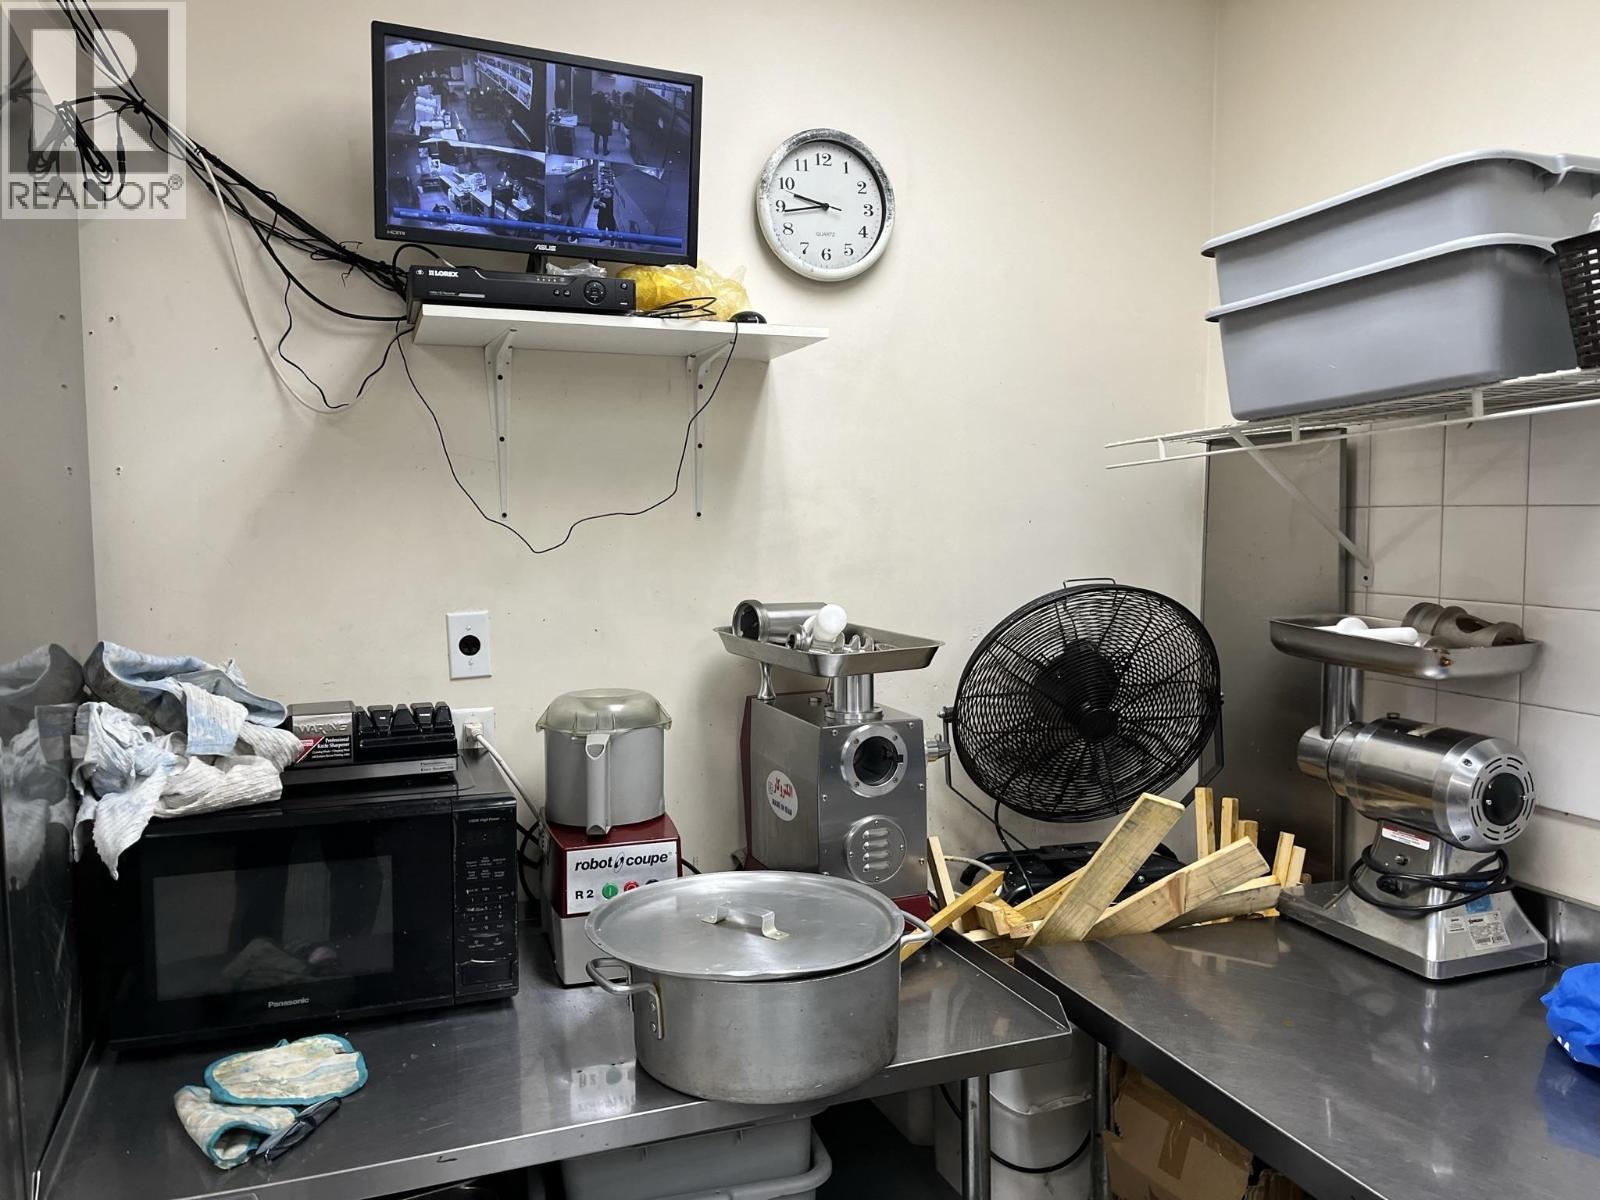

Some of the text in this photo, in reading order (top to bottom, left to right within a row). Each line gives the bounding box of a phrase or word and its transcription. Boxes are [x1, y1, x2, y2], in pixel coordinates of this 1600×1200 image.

[794, 159, 808, 172] 11
[816, 152, 832, 167] 12
[844, 161, 849, 174] 1
[779, 177, 795, 190] 10
[857, 181, 867, 194] 2
[775, 200, 786, 213] 9
[863, 204, 874, 217] 3
[782, 222, 794, 235] 8
[858, 226, 868, 238] 4
[534, 244, 557, 252] ASUS
[799, 241, 809, 255] 7
[821, 248, 832, 261] 6
[844, 243, 854, 256] 5
[434, 269, 459, 278] LOREX
[574, 853, 668, 872] robot coupe
[575, 889, 594, 900] R 2
[267, 997, 310, 1008] Panasonic
